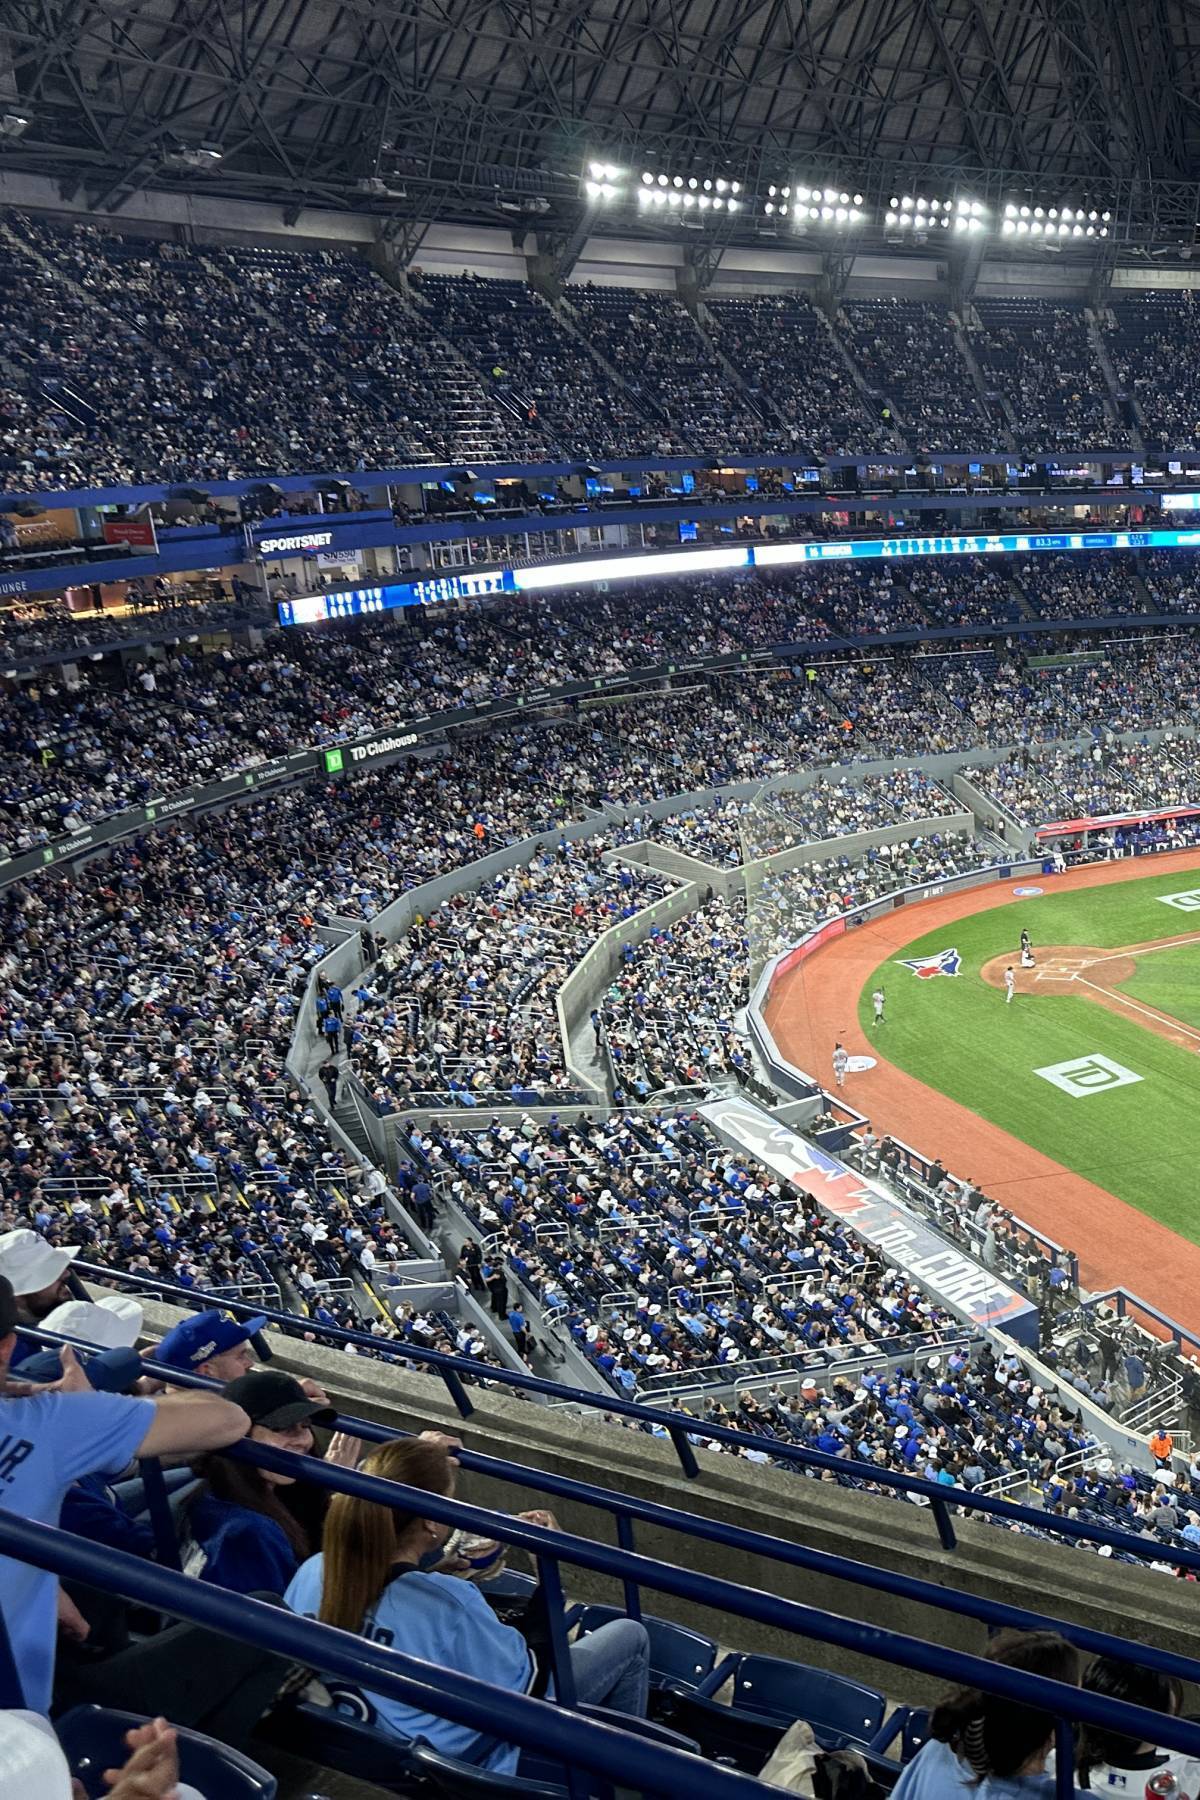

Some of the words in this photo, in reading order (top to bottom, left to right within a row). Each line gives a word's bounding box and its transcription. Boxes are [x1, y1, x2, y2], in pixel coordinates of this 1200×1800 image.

[260, 532, 333, 553] SPORTSNET
[0, 581, 28, 594] UNGE
[350, 747, 367, 760] TD
[366, 733, 418, 756] Clubhouse
[1060, 1059, 1121, 1088] TD
[866, 1220, 918, 1250] TO
[885, 1243, 923, 1266] THE
[908, 1249, 1014, 1317] CORE
